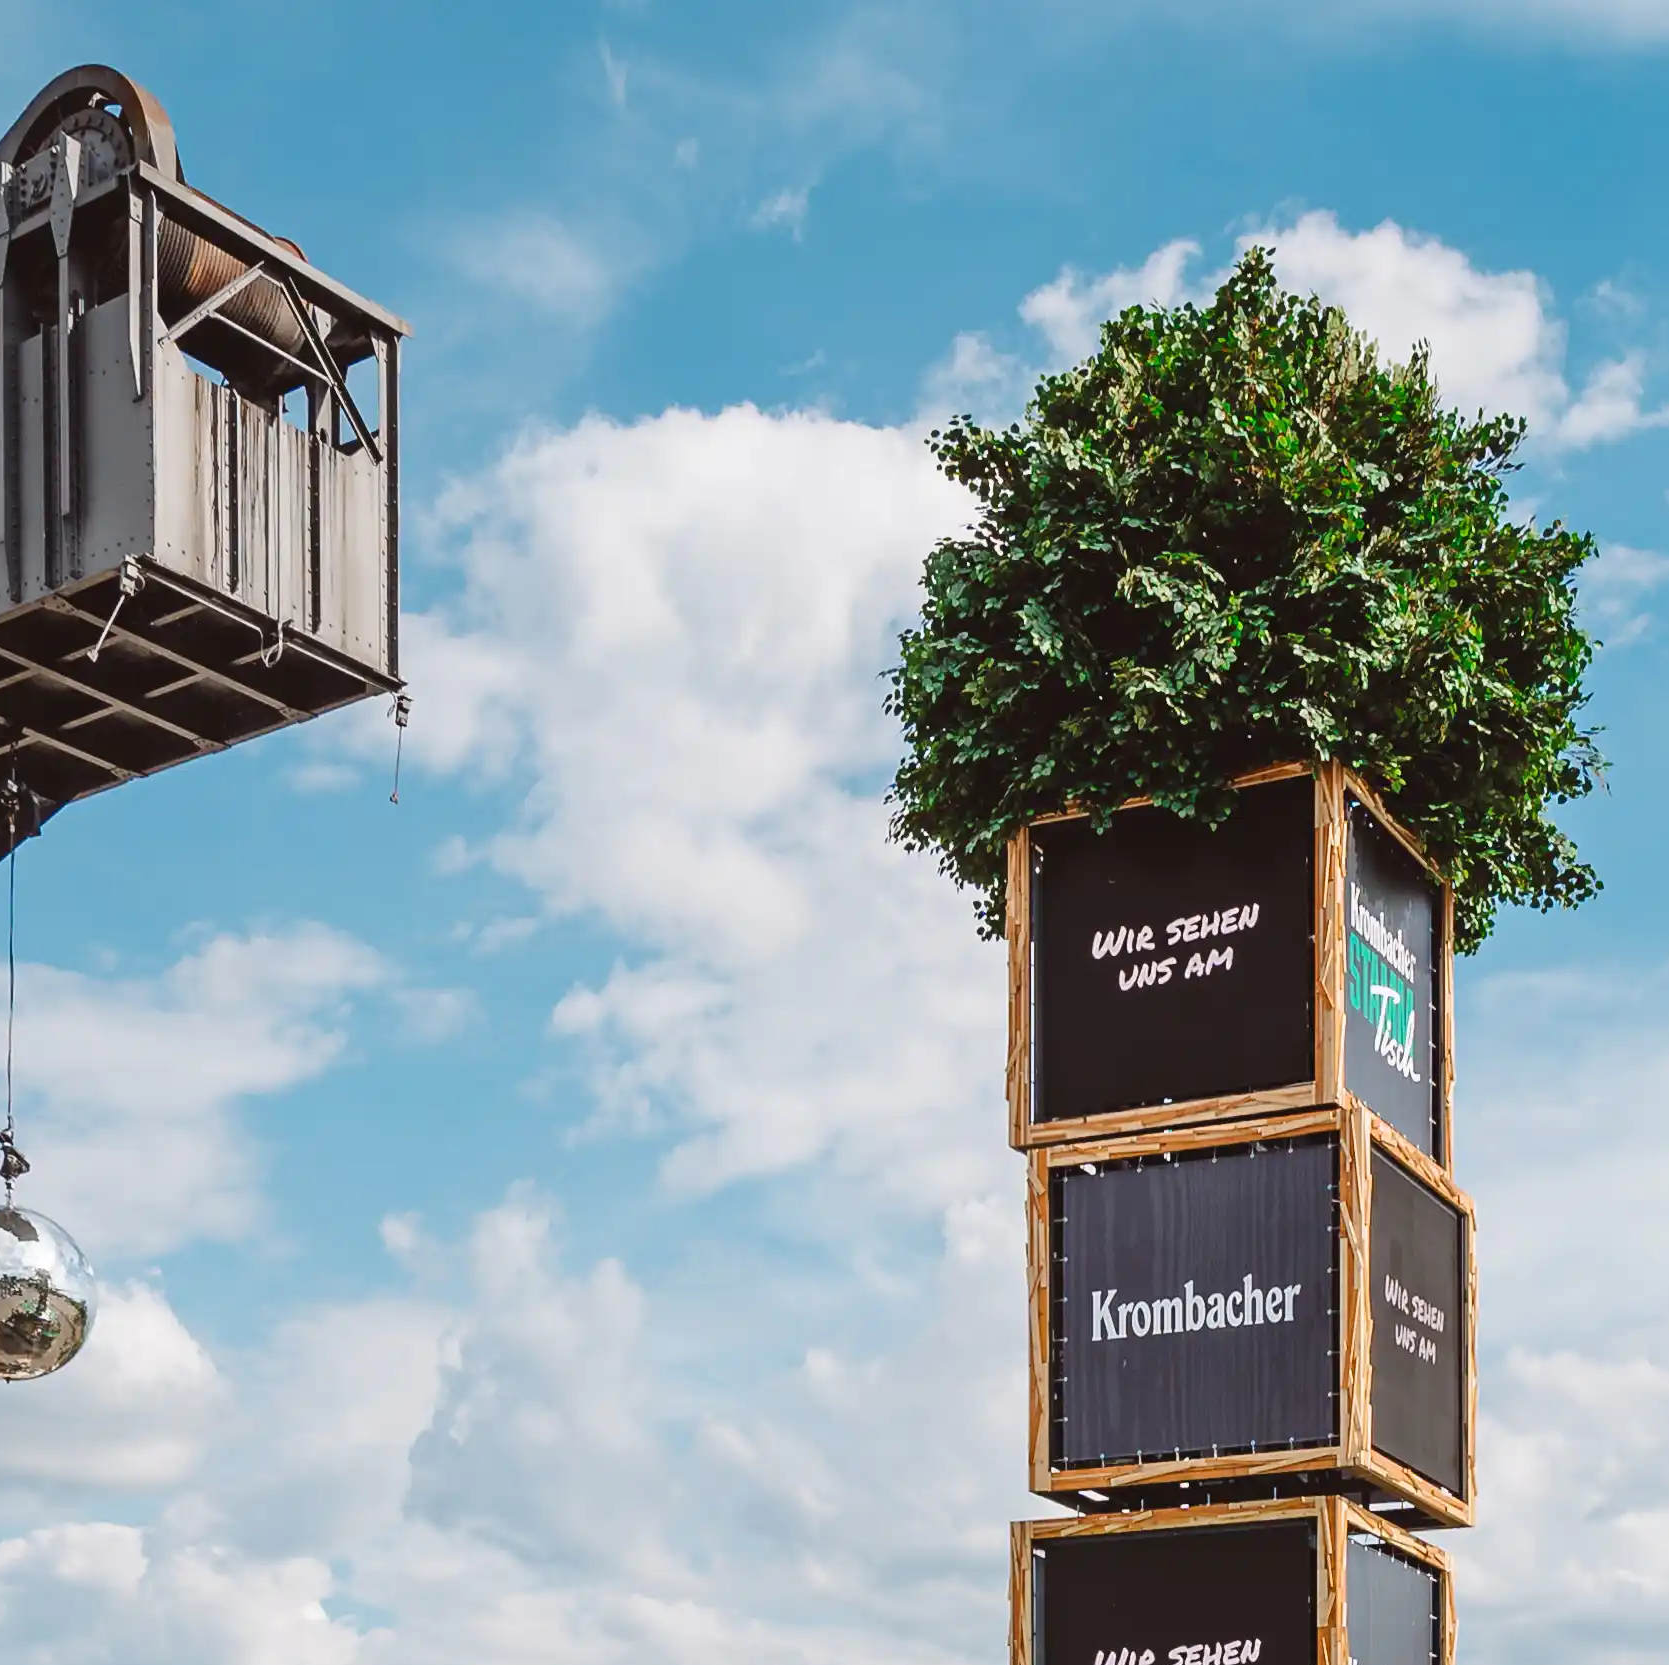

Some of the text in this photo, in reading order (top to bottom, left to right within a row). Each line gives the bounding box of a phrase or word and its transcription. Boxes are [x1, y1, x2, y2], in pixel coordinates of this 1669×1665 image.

[1092, 903, 1259, 960] WIR SEHEN
[1350, 881, 1417, 984] Krombacher
[1119, 946, 1234, 991] UNS AM
[1370, 985, 1421, 1082] Tisch
[1091, 1273, 1302, 1342] Krombacher
[1385, 1273, 1444, 1332] WIR SEHEN
[1395, 1323, 1436, 1365] UNS AM
